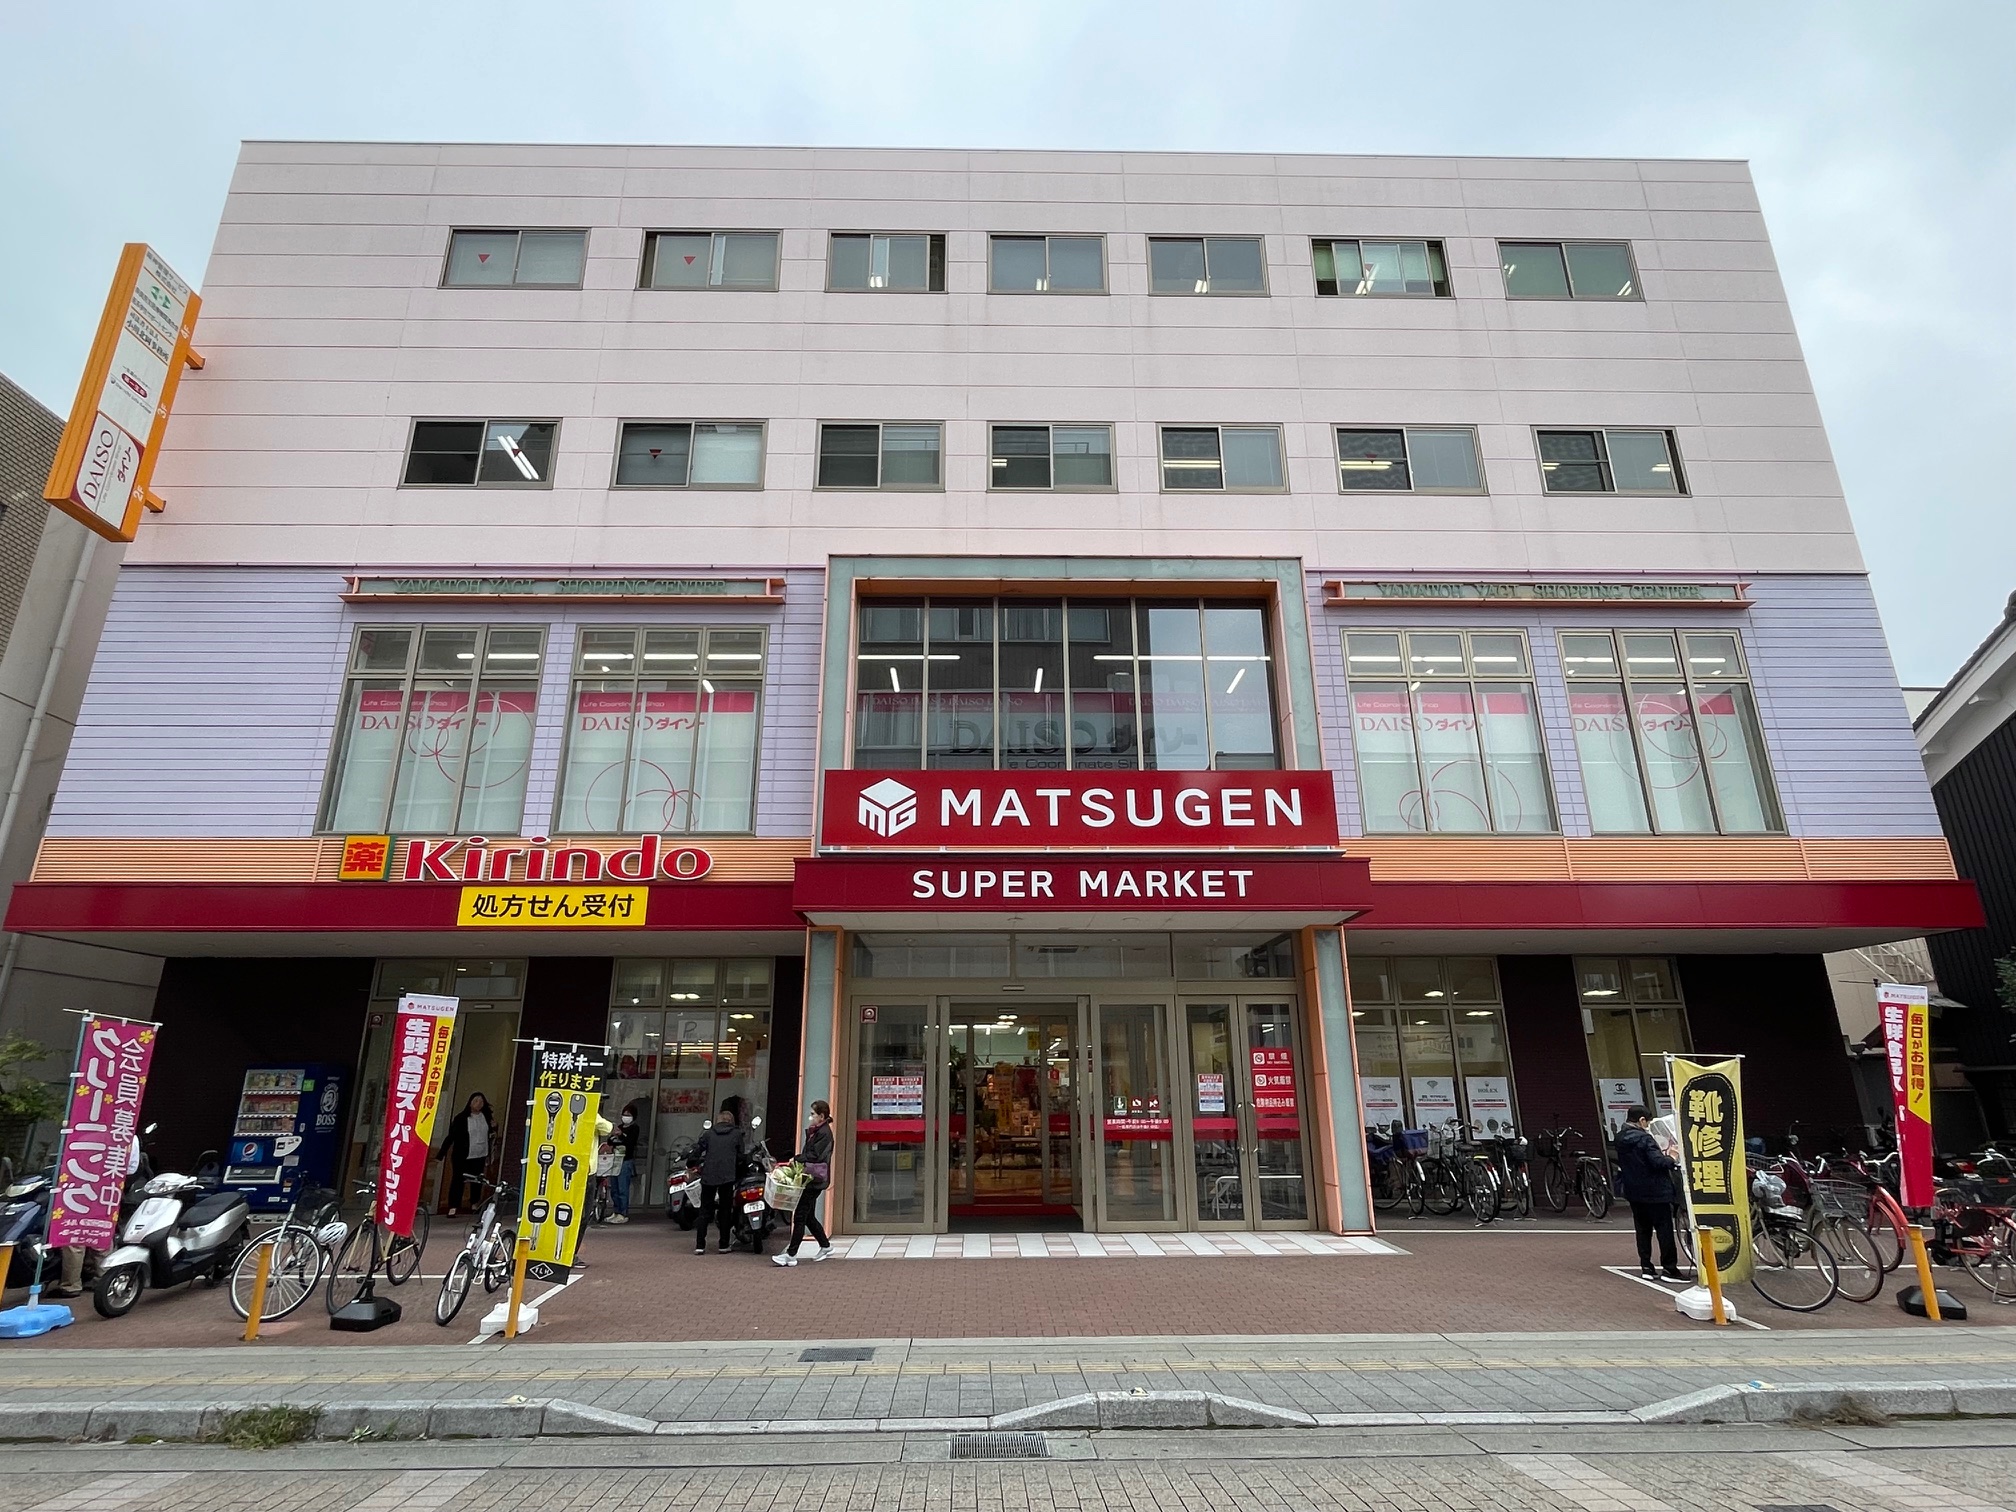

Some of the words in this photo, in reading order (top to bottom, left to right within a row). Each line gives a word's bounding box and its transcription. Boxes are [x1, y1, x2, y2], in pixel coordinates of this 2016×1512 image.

[157, 403, 168, 419] 3F
[83, 430, 114, 500] DAISO
[117, 446, 132, 483] ダイソー
[133, 485, 144, 501] 2F
[394, 579, 481, 595] YAMATOH
[556, 579, 648, 595] SHOPPING
[652, 579, 727, 595] CENTER
[1376, 583, 1463, 598] YAMATOH
[1533, 584, 1622, 599] SHOPPING
[1628, 584, 1705, 600] CENTER
[950, 719, 1097, 754] DAISO
[940, 787, 1303, 828] MATSUGEN
[346, 842, 383, 872] 薬
[402, 833, 714, 883] Kirindo
[912, 869, 1055, 899] SUPER
[1078, 869, 1254, 899] MARKET
[471, 893, 635, 919] 処方せん受付
[417, 1003, 455, 1012] MATSUGEN
[541, 1051, 603, 1072] 特殊キー
[539, 1070, 601, 1091] 作ります
[316, 1113, 337, 1126] BOSS
[1688, 1090, 1727, 1194] 靴修理
